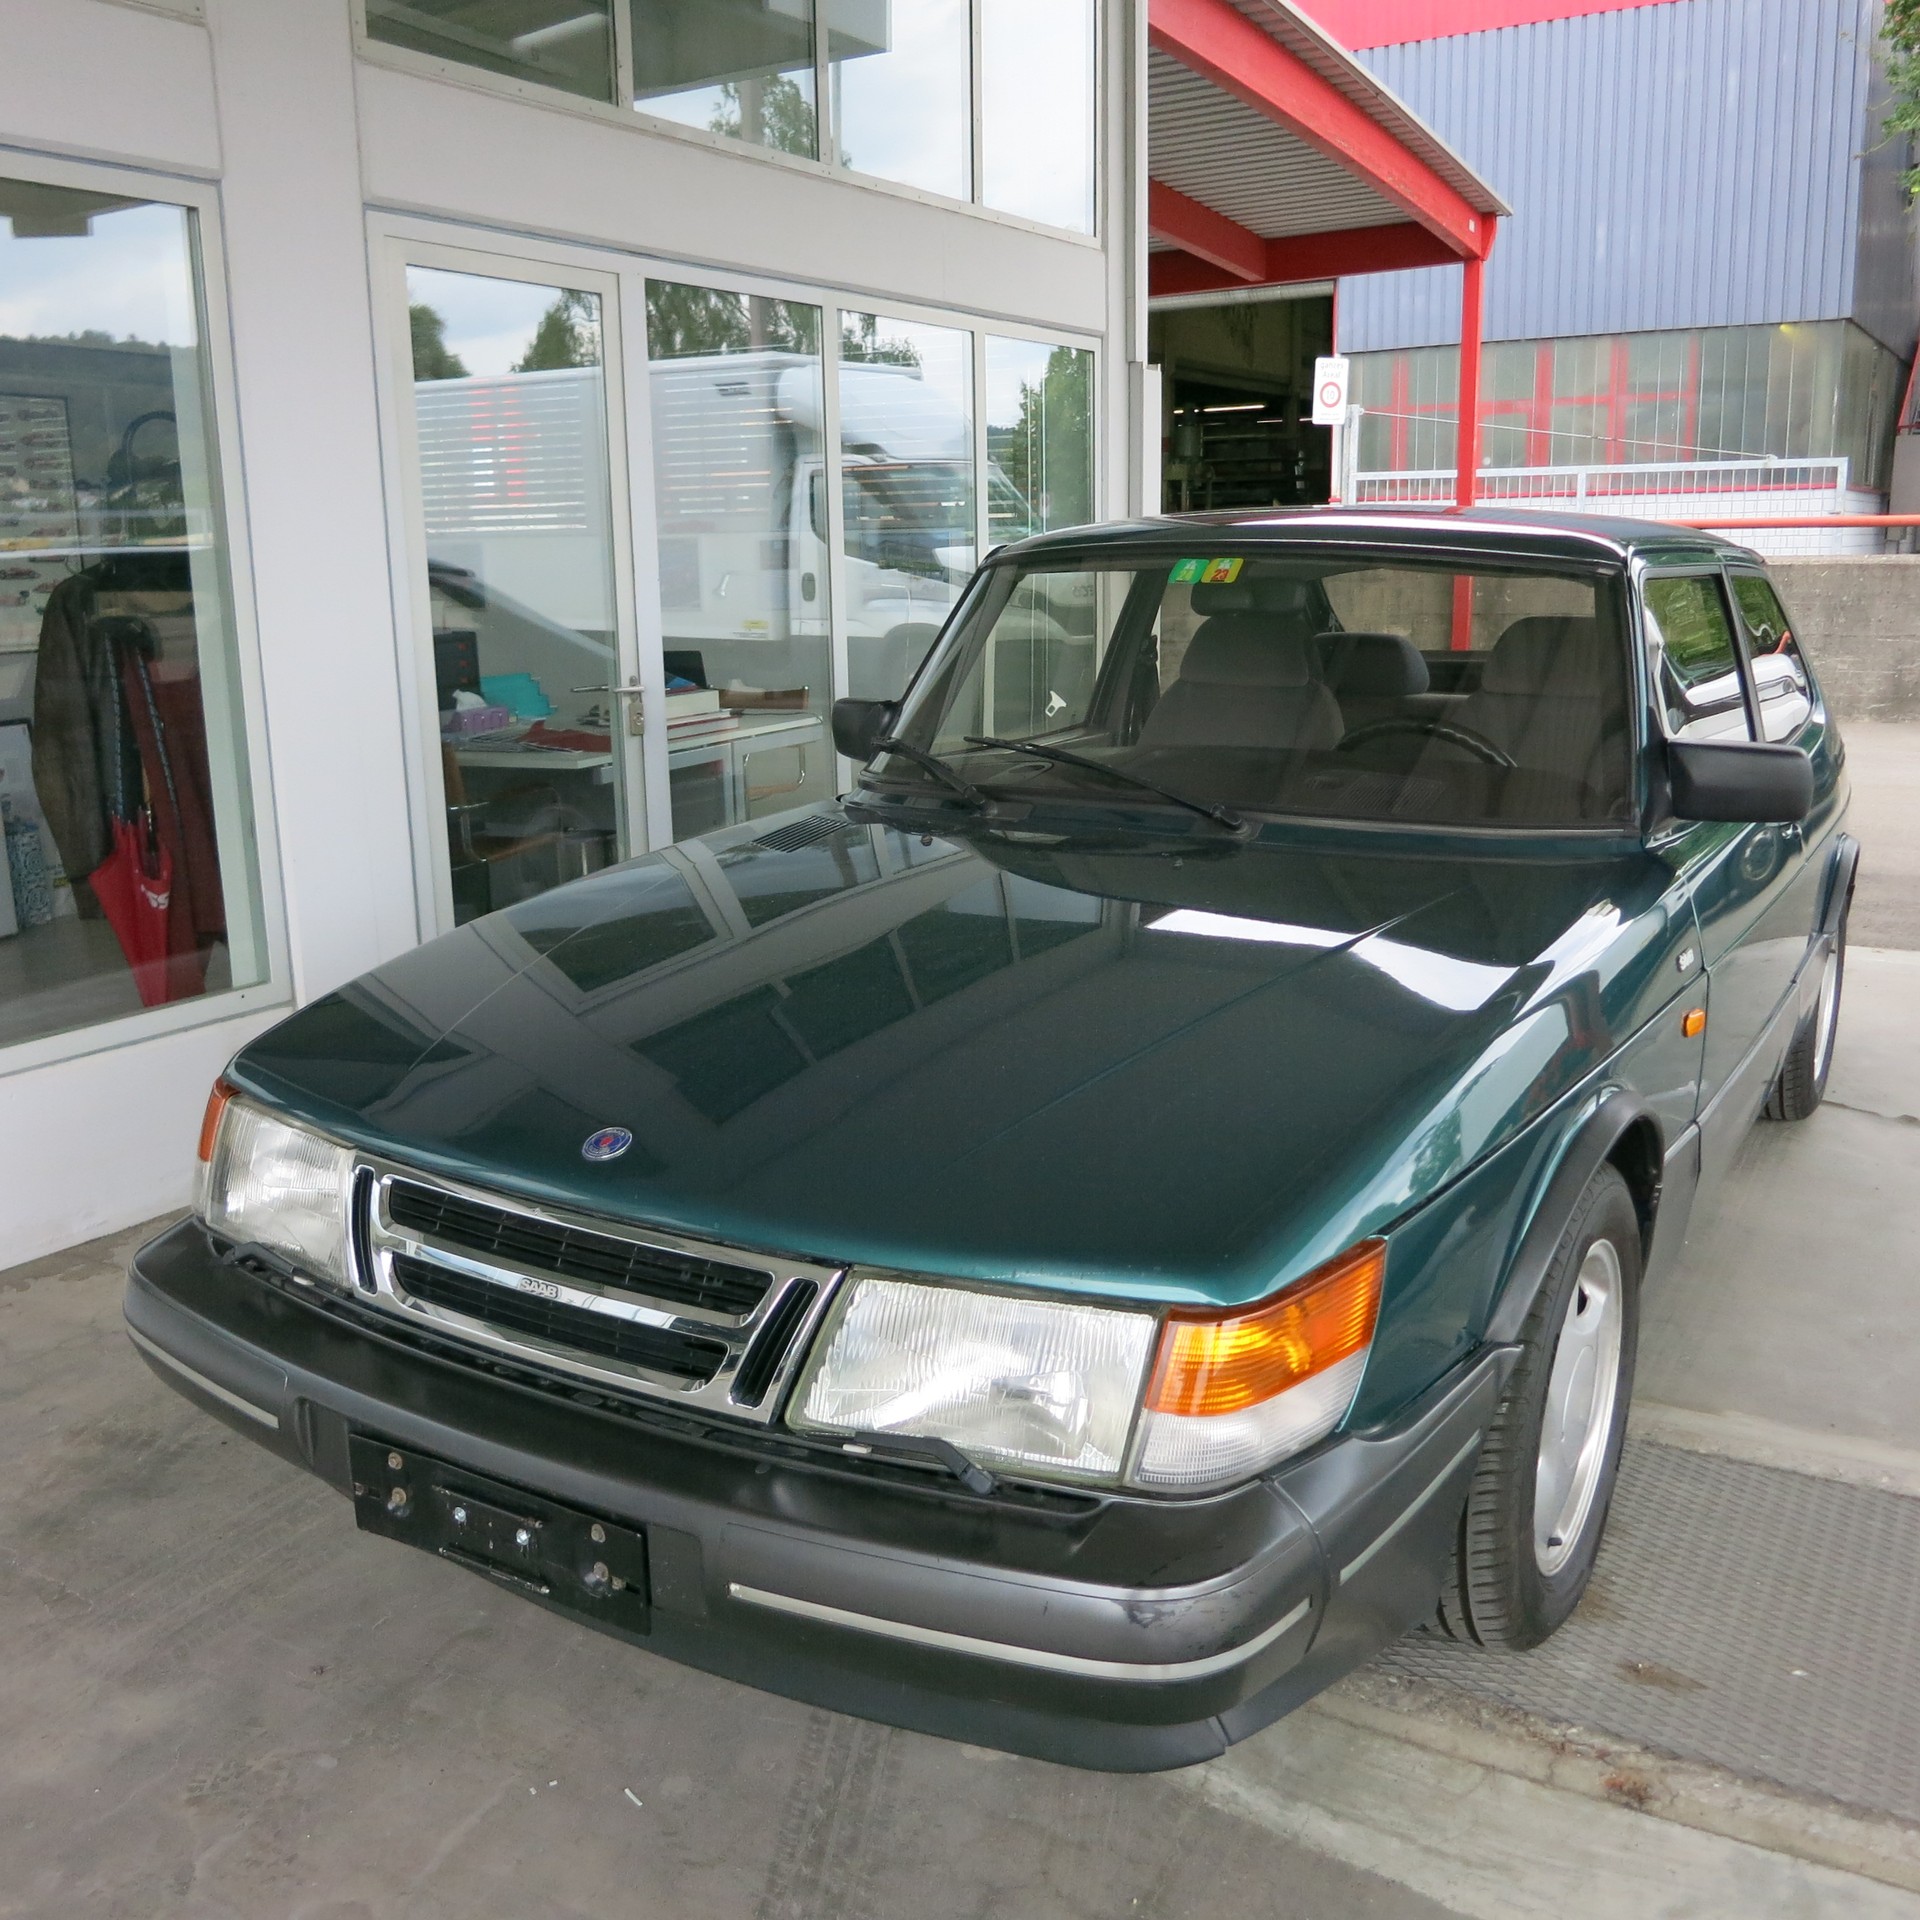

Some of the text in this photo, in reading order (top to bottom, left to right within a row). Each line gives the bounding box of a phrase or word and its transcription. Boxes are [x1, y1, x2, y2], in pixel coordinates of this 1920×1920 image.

[1326, 390, 1336, 400] 10
[1210, 568, 1230, 581] 23
[520, 1278, 558, 1299] SAAB
